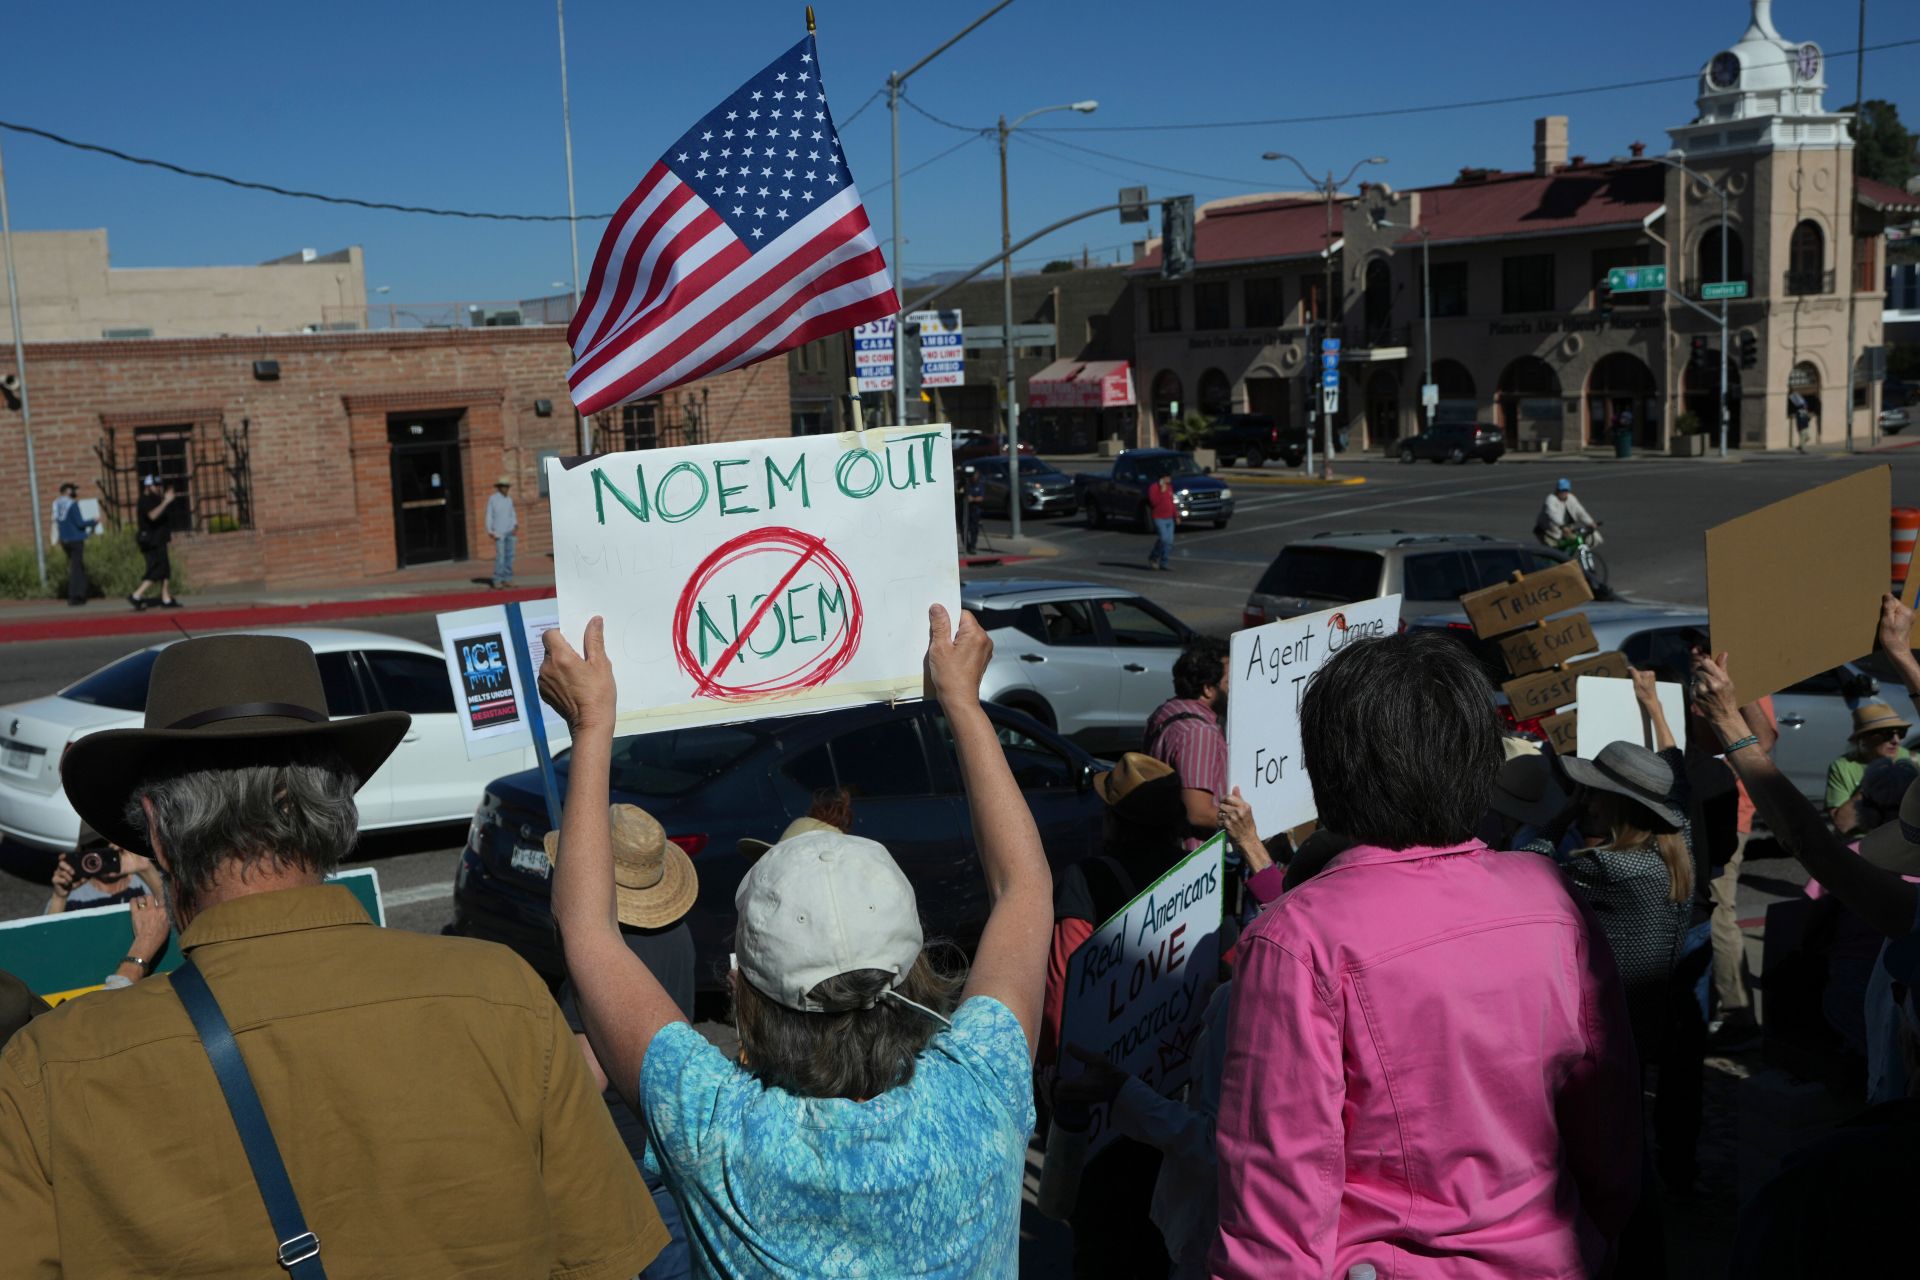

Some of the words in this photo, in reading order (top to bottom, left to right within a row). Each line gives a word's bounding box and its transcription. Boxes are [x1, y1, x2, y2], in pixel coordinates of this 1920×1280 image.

[871, 318, 895, 333] STA
[858, 355, 869, 363] NO
[927, 351, 938, 359] NO
[861, 340, 892, 349] CASA
[921, 375, 957, 384] ASHING
[926, 362, 959, 372] CAMBIO
[591, 453, 811, 524] NOEM
[836, 431, 947, 498] OUT
[1491, 583, 1562, 621] THUGS
[696, 582, 849, 667] NOEM
[462, 641, 503, 674] ICE
[1246, 624, 1315, 685] Agent
[1509, 644, 1541, 666] ICE
[468, 692, 491, 704] MELTS
[491, 688, 513, 700] UNDER
[471, 705, 516, 720] RESISTANCE
[1255, 748, 1288, 788] For
[1079, 912, 1128, 998] Real
[1138, 863, 1217, 947] Americans
[1108, 923, 1187, 1024] LOVE
[1104, 974, 1199, 1064] mocracy
